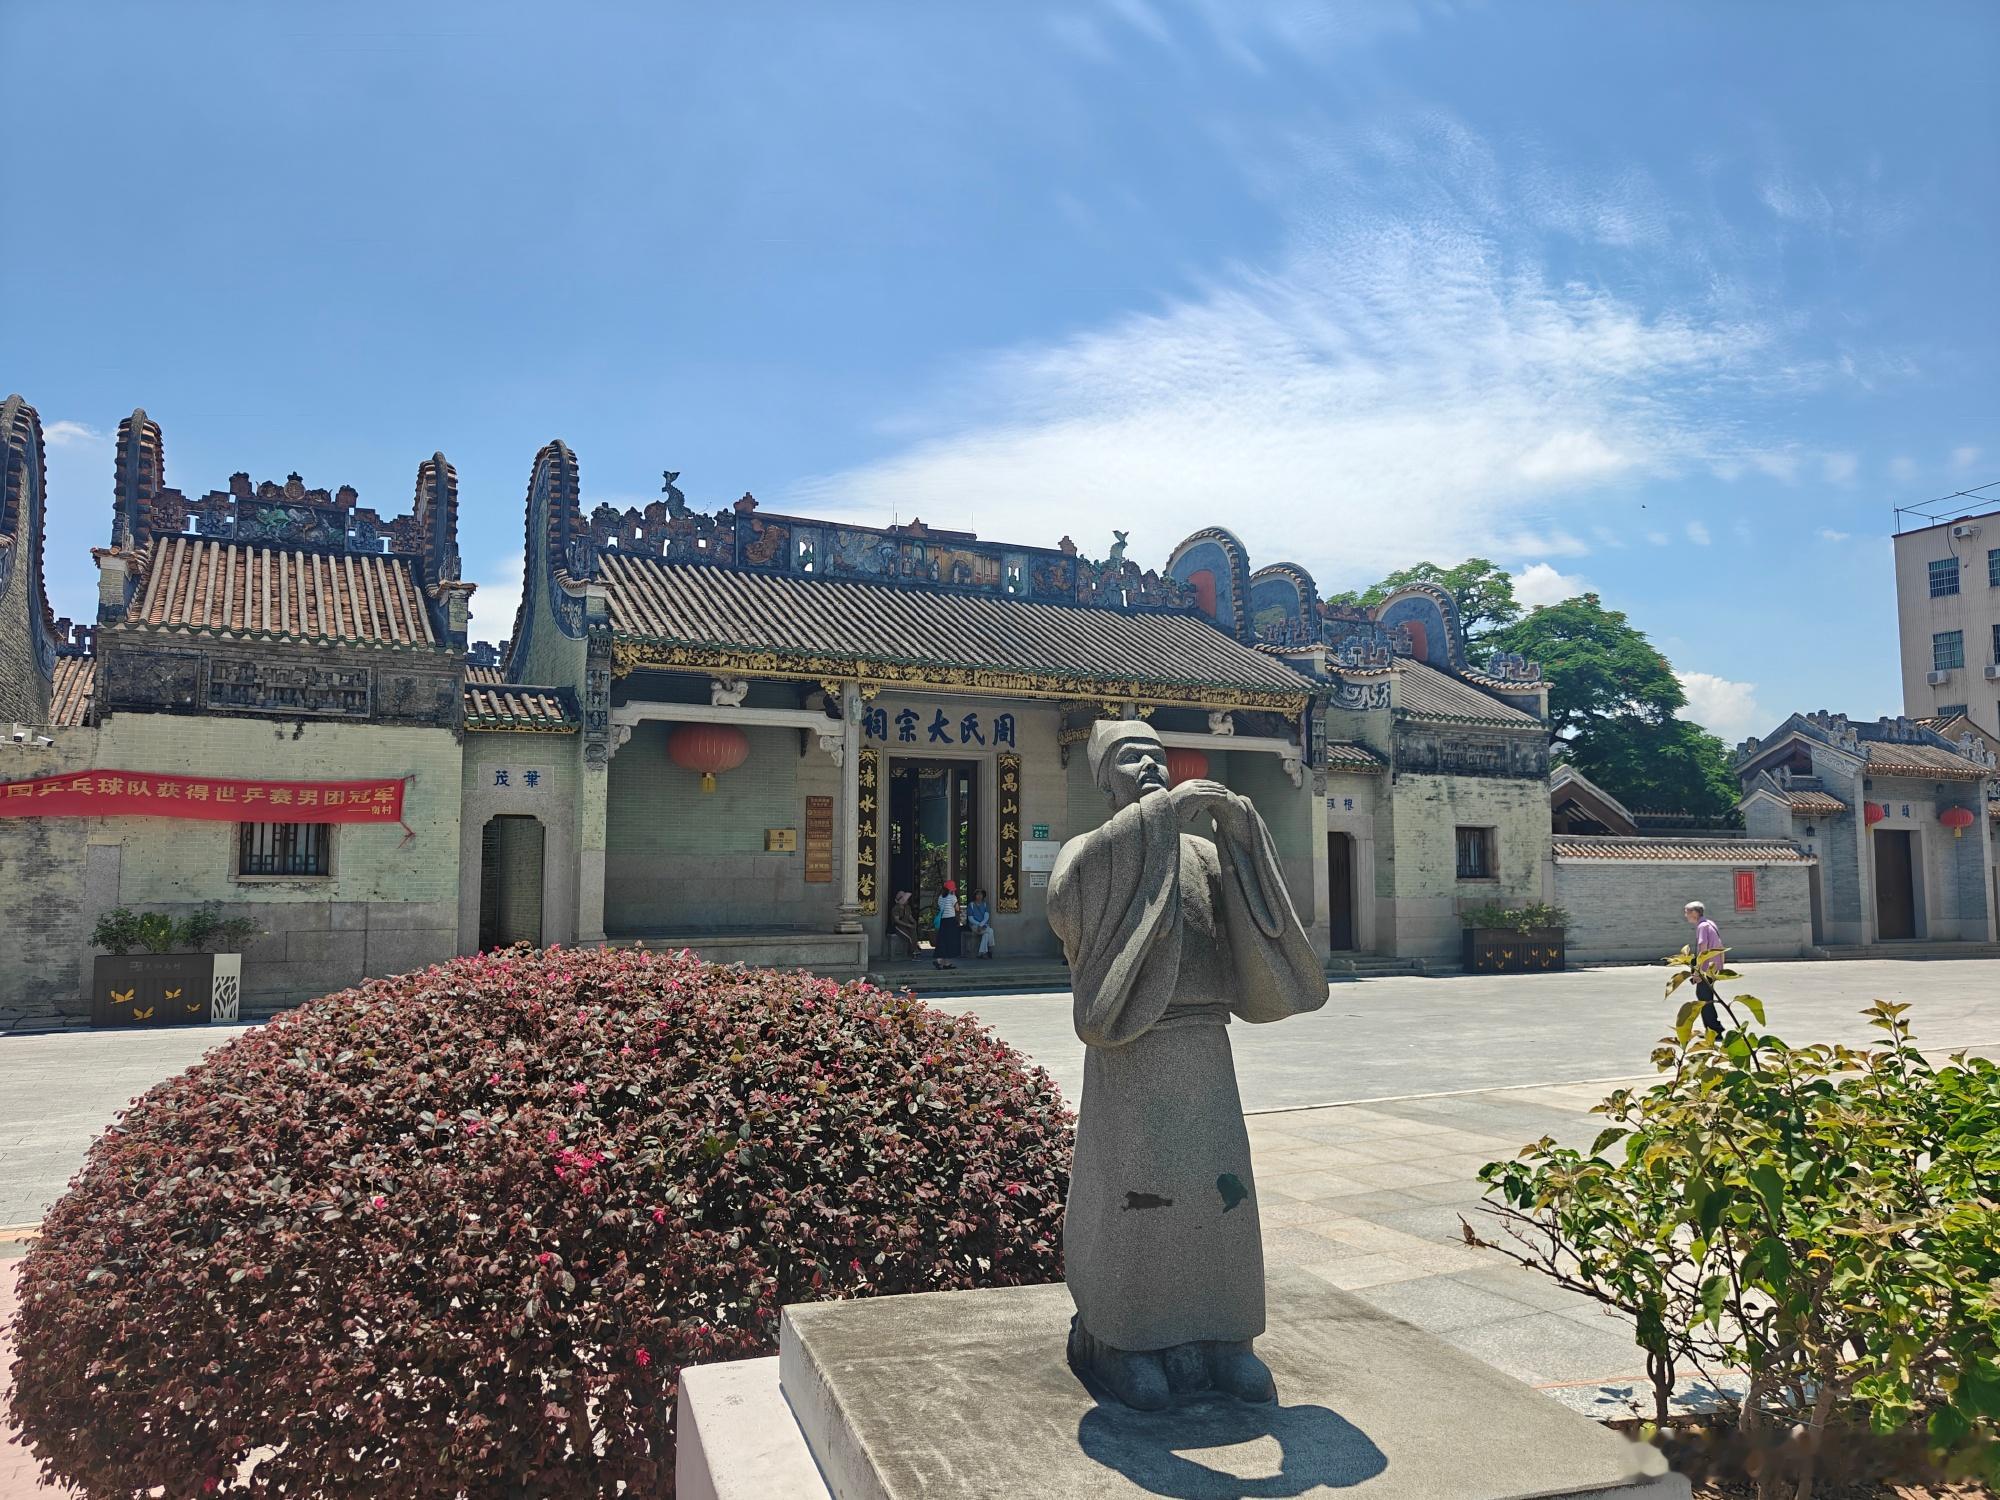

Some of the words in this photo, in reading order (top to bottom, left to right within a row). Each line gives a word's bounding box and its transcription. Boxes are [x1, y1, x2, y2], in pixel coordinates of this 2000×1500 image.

[862, 706, 1016, 748] 周氏大宗祠
[0, 777, 395, 806] 国乒乓球队获得世乒赛男团冠军
